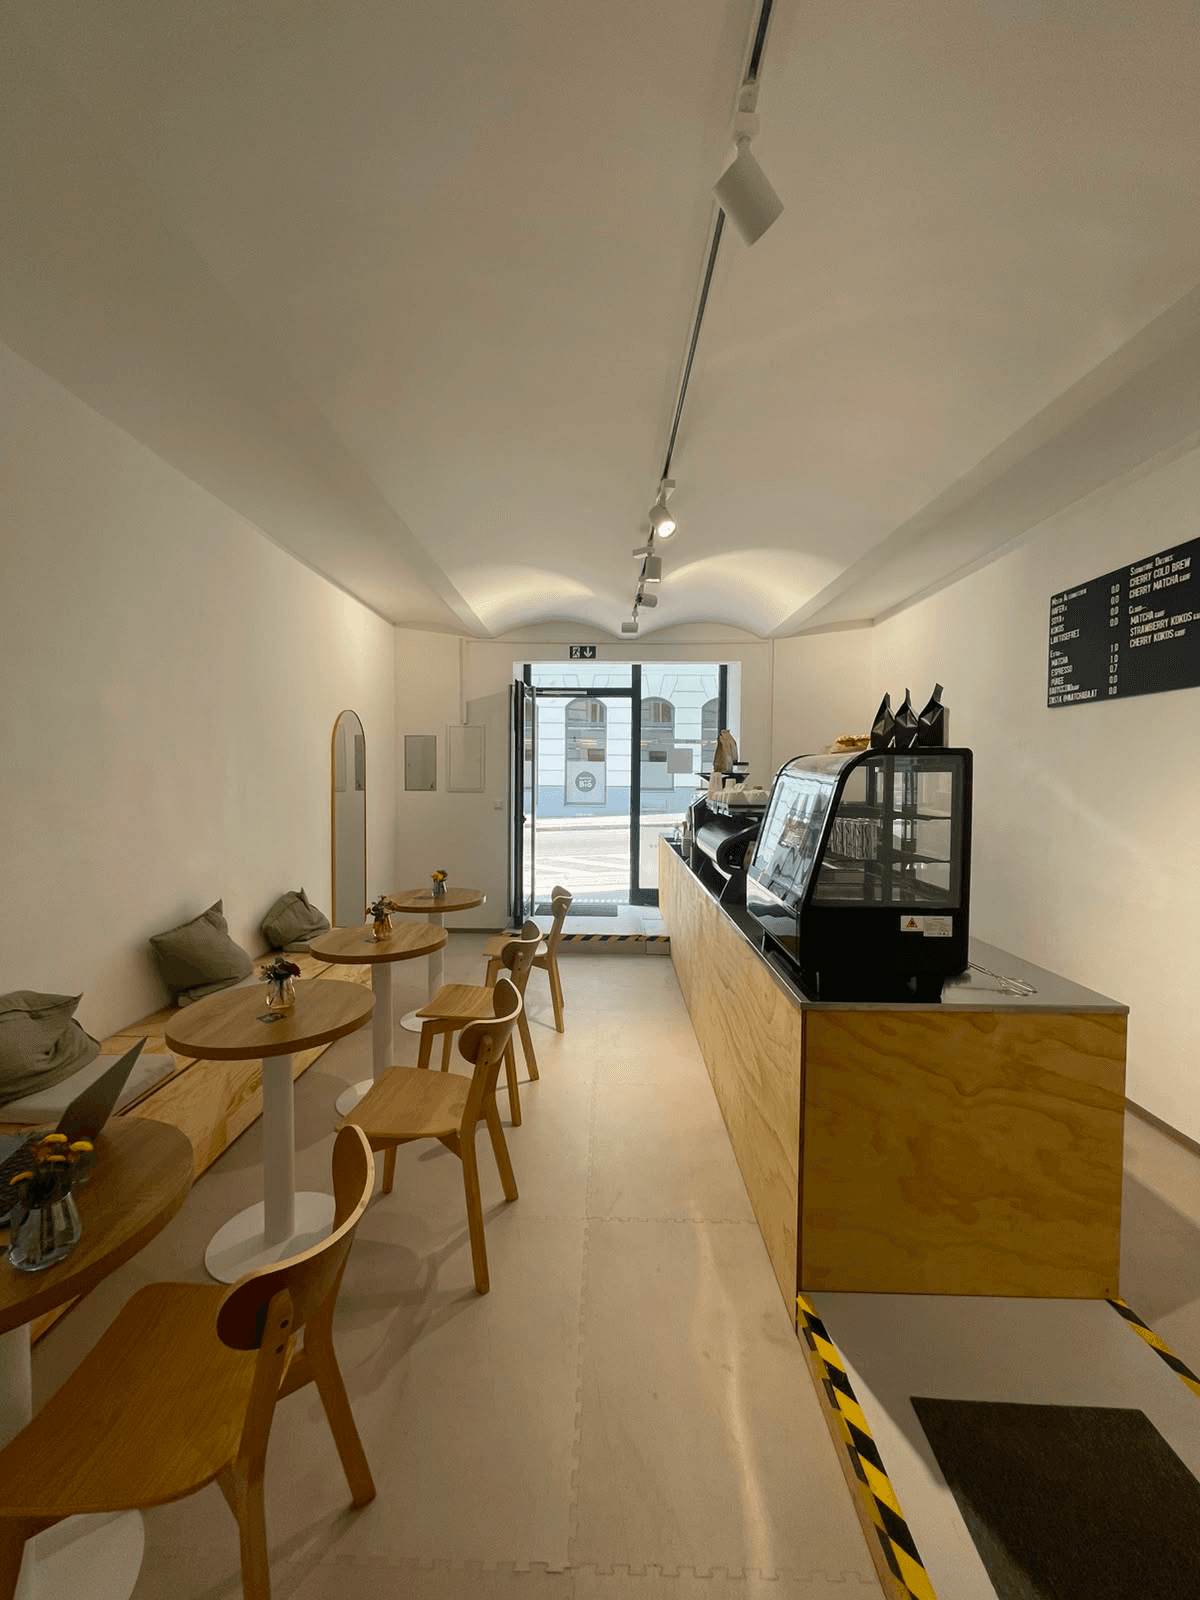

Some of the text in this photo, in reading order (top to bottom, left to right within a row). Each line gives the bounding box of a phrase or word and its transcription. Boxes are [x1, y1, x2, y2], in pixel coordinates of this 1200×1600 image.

[1129, 571, 1152, 587] CHERRY
[1153, 565, 1170, 579] COLD
[1171, 557, 1191, 573] BREW
[1129, 583, 1151, 599] CHERRY
[1153, 574, 1179, 591] MATCHA
[1129, 618, 1170, 637] STRAWBERRY
[1170, 611, 1193, 626] KOKOS
[1130, 610, 1154, 625] MATCHA
[1129, 634, 1152, 648] CHERRY
[1153, 629, 1174, 643] KOKOS
